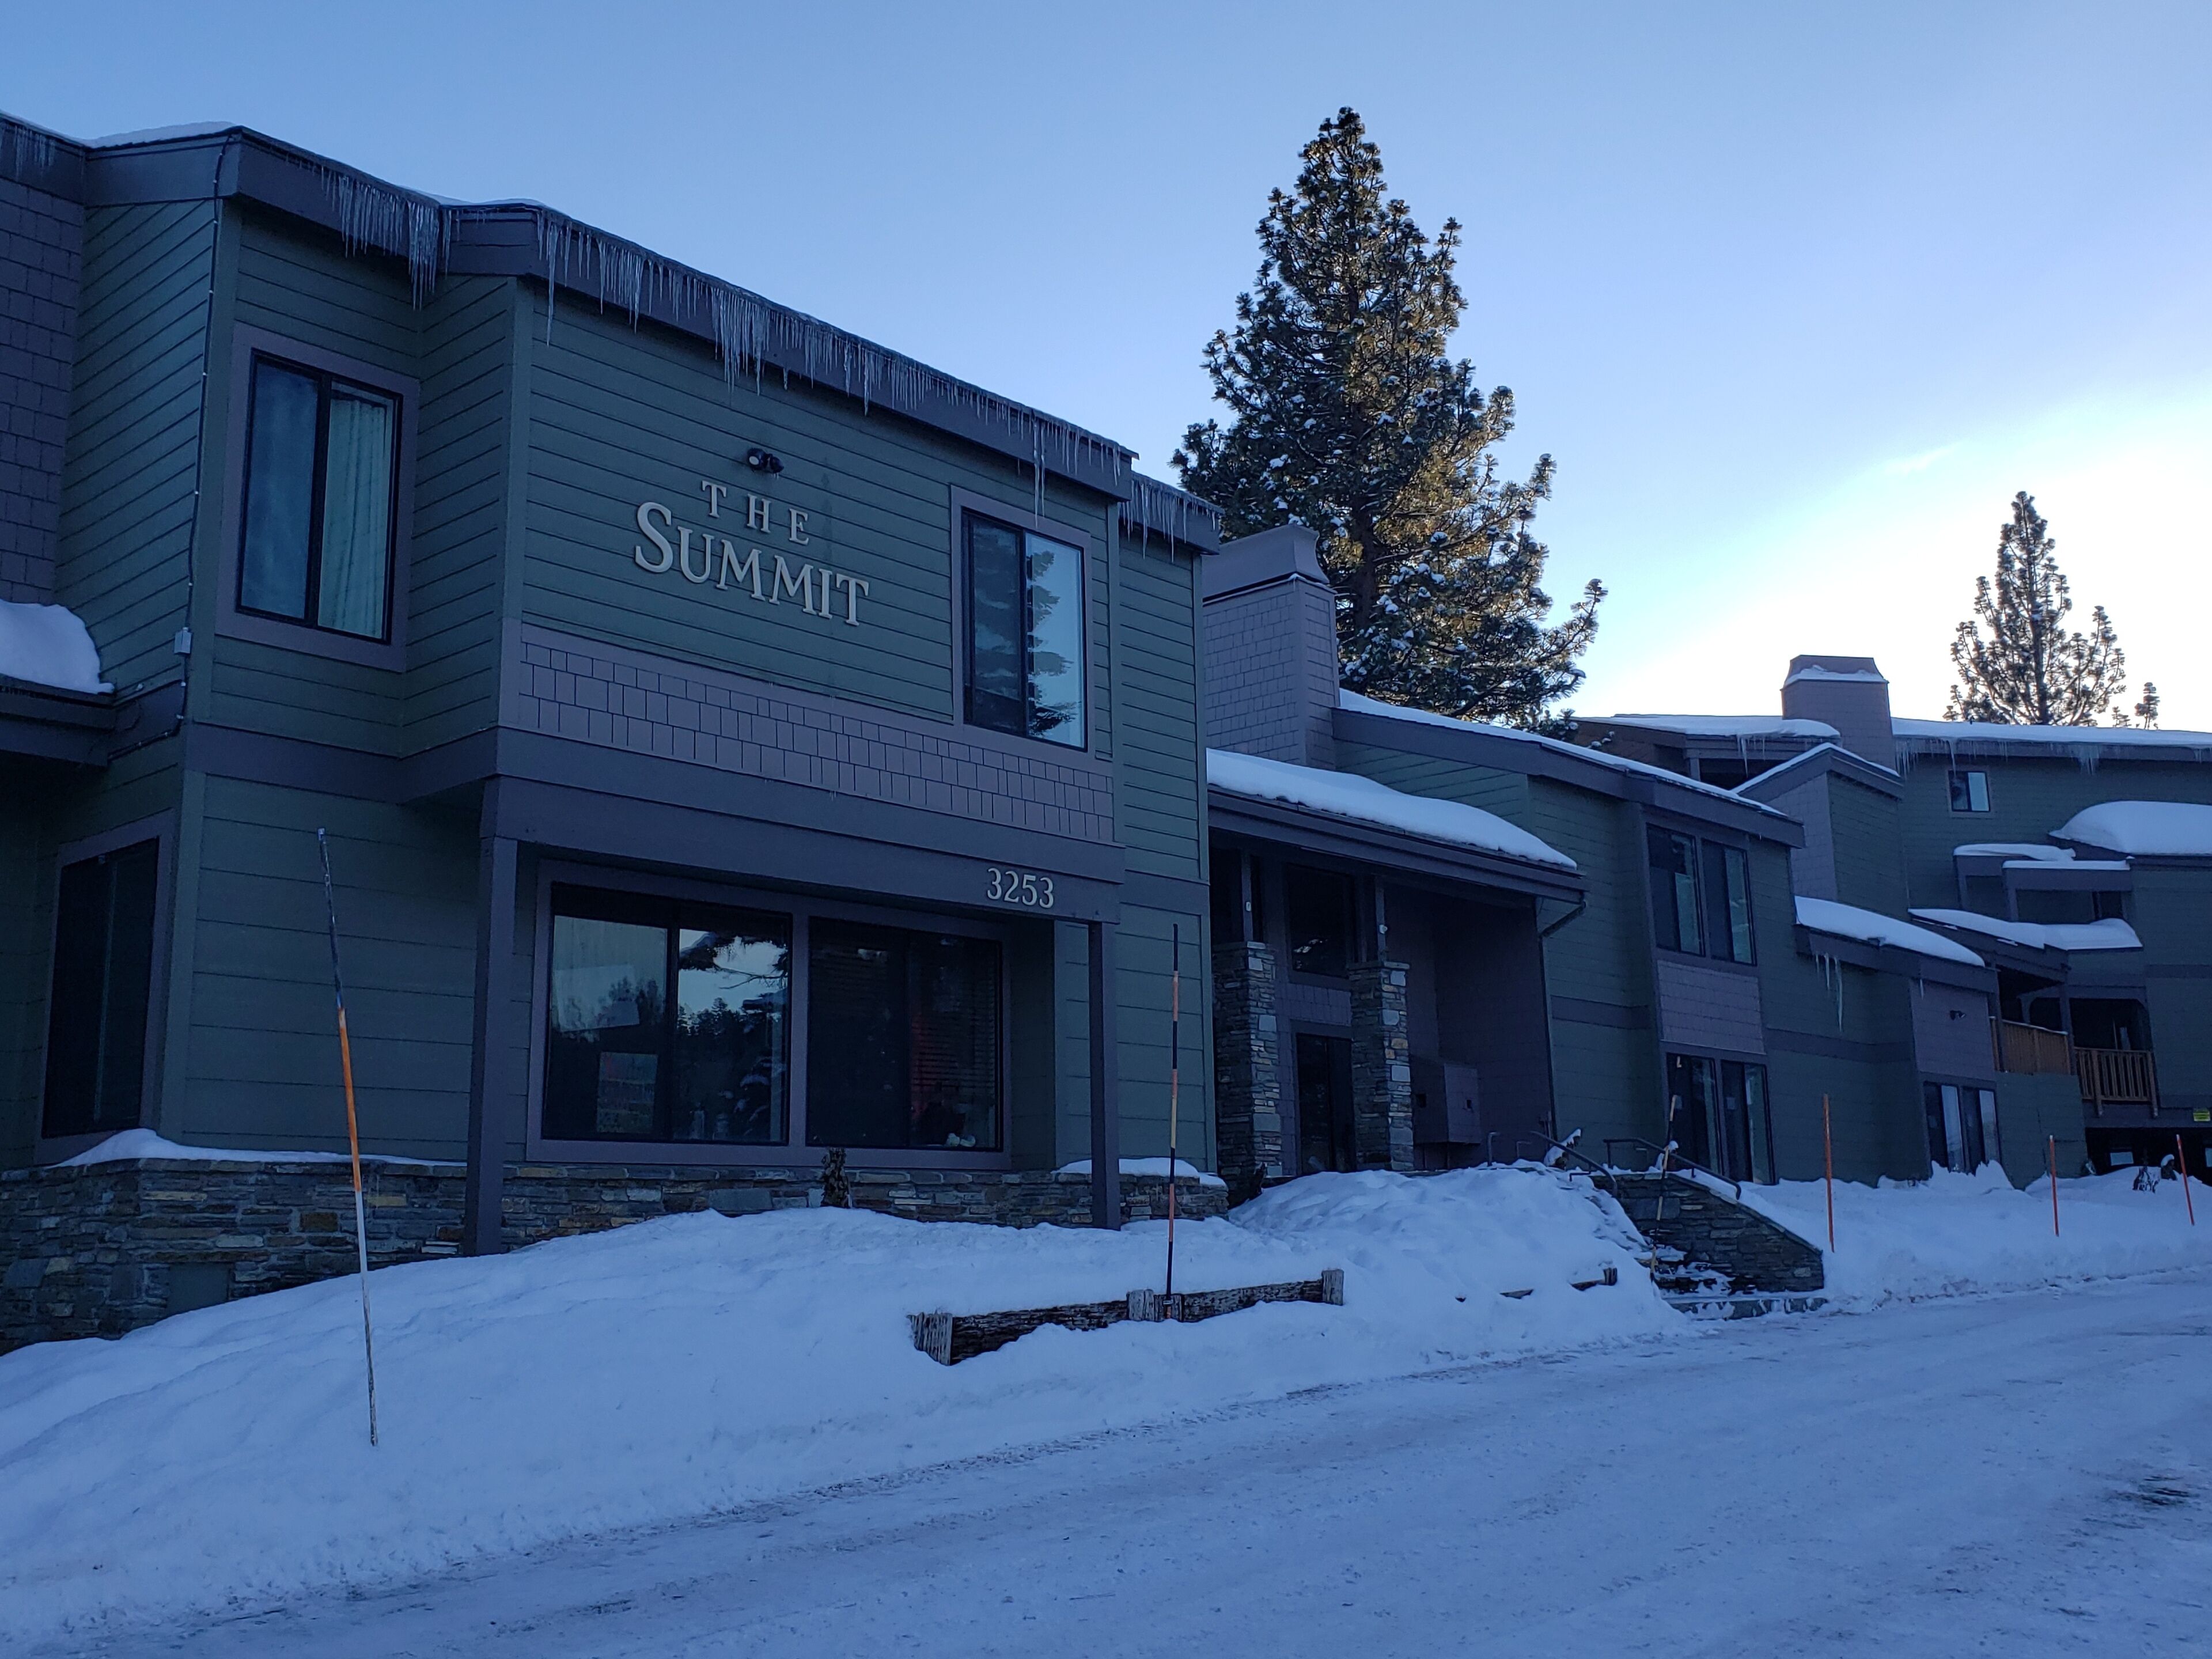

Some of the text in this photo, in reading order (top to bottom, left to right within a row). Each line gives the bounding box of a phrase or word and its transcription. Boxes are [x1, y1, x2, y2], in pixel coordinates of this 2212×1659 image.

[702, 480, 809, 545] THE
[635, 502, 870, 626] SUMMIT
[987, 868, 1054, 908] 3253
